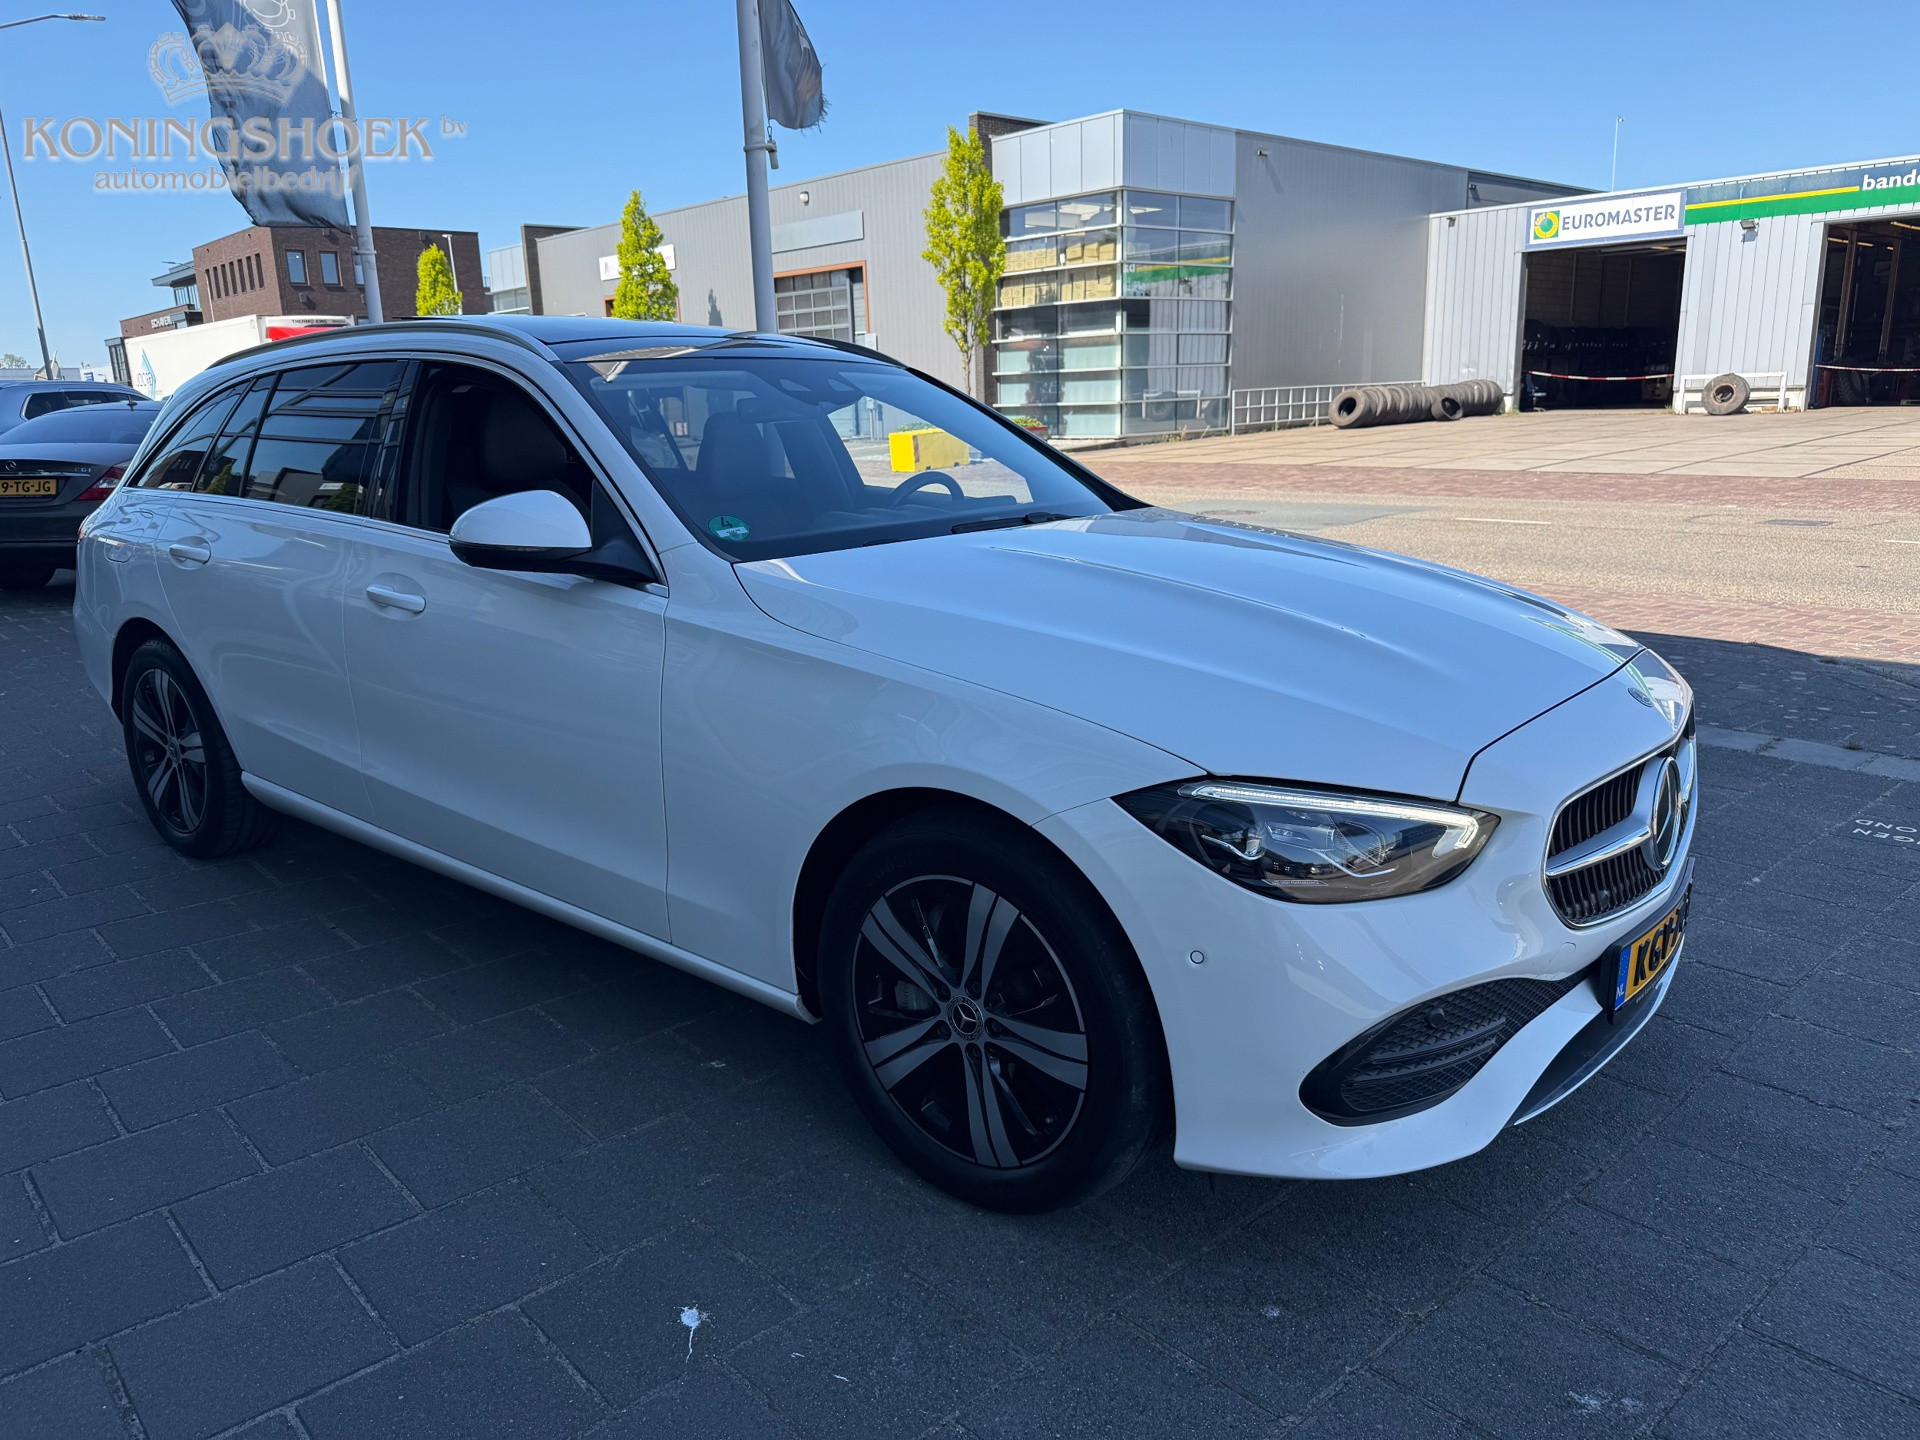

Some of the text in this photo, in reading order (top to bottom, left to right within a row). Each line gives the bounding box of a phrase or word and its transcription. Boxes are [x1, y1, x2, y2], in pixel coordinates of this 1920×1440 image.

[1862, 168, 1920, 191] band
[1561, 203, 1676, 231] EUROMASTER
[1852, 828, 1920, 845] GEN
[1615, 982, 1625, 1000] NL
